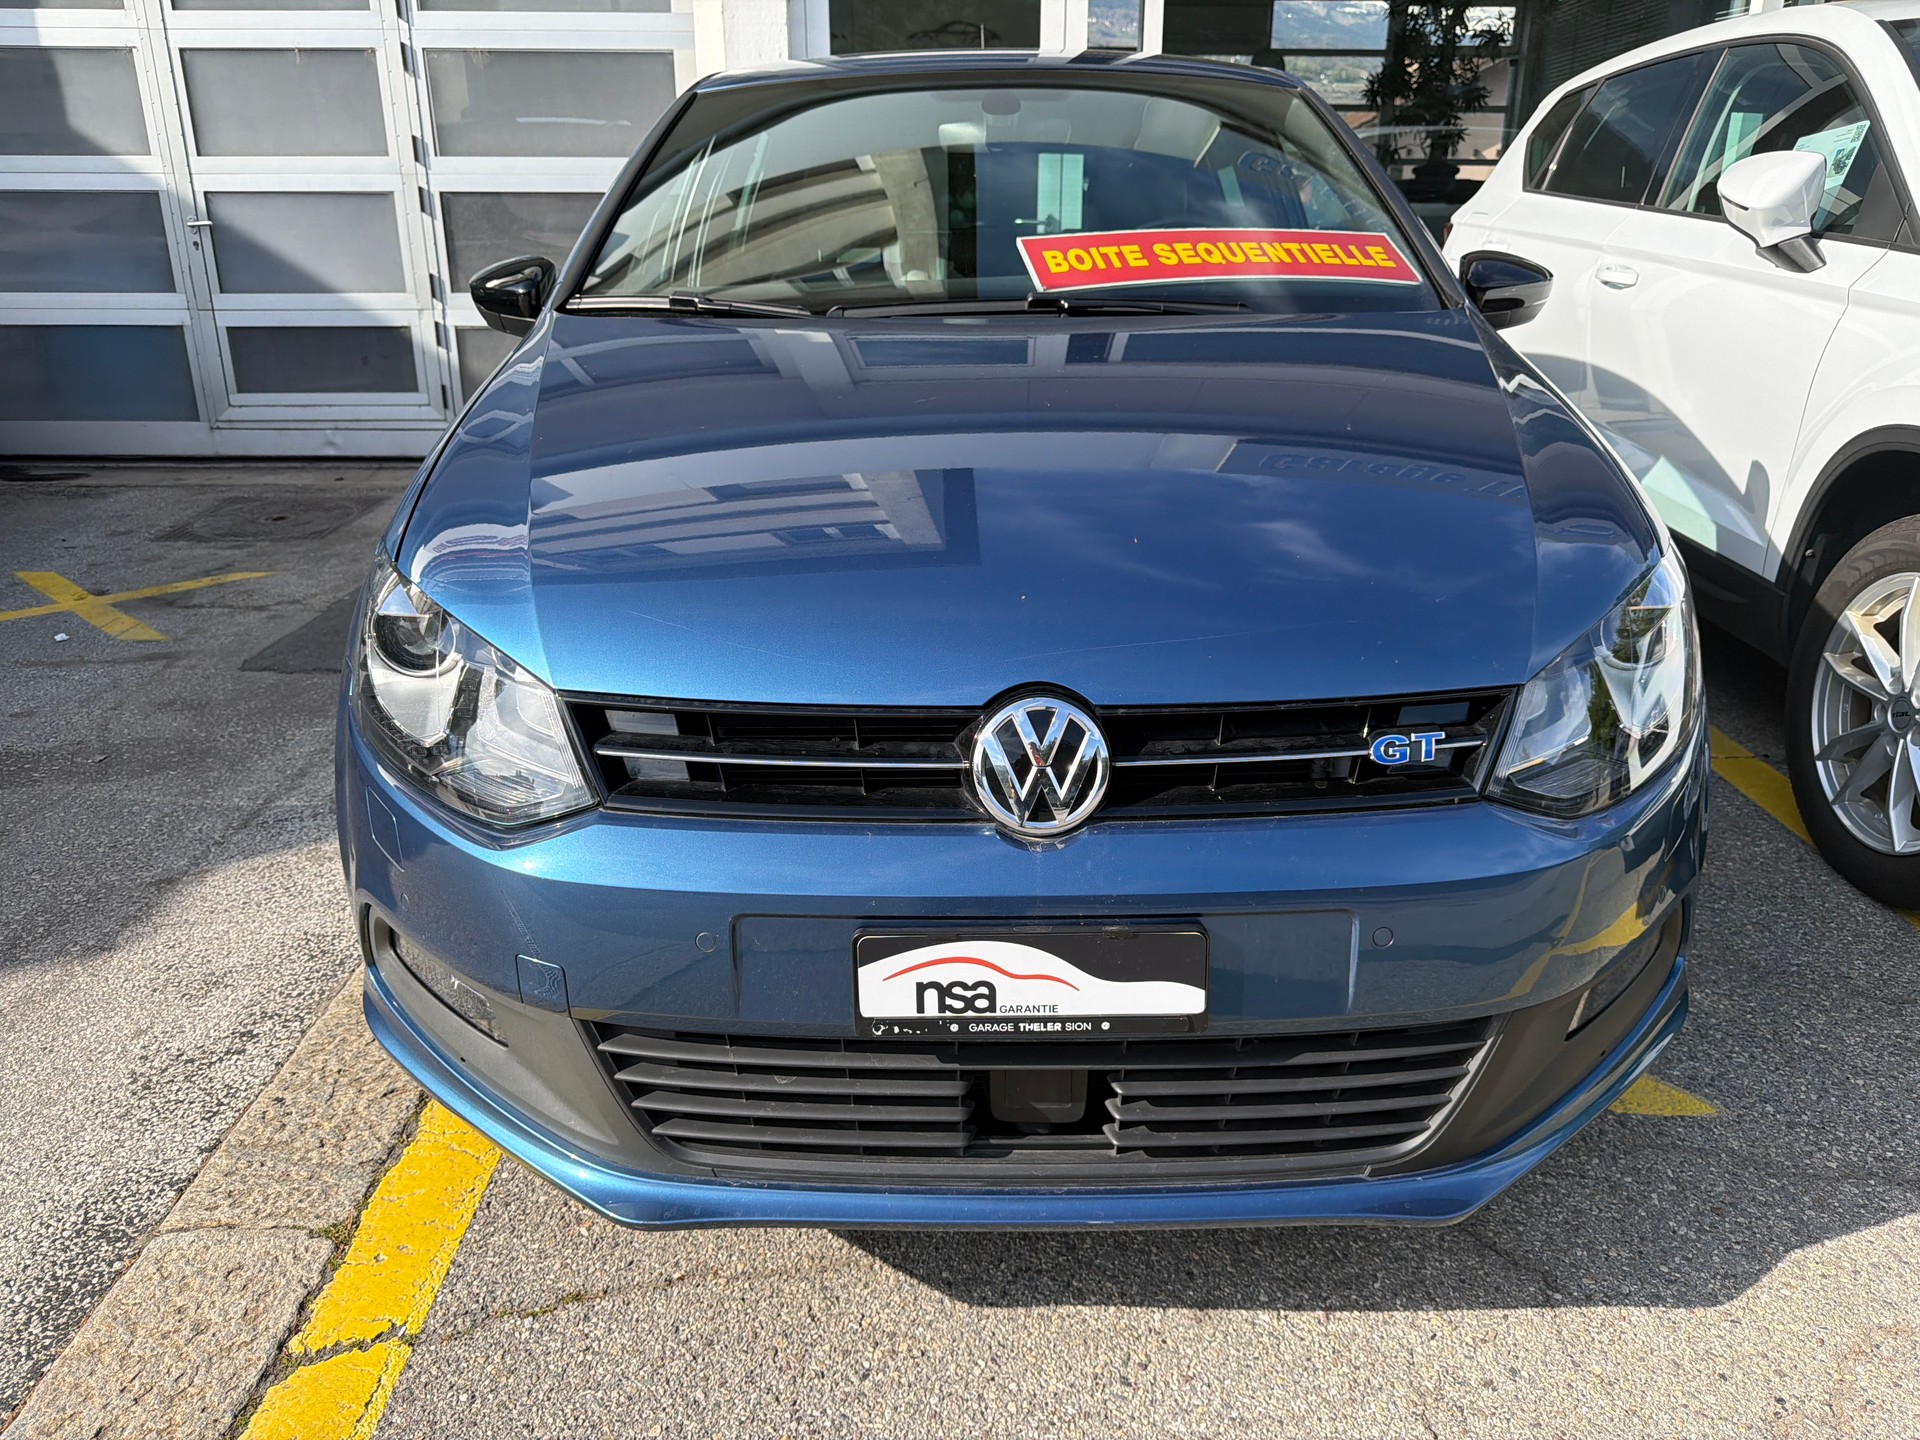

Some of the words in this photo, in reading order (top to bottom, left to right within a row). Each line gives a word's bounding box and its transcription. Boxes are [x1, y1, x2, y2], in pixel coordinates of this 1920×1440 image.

[1042, 244, 1150, 274] BOITE
[1152, 241, 1397, 268] SEQUENTIELLE
[1369, 731, 1446, 765] GT
[915, 980, 997, 1015] nsa
[999, 1004, 1060, 1014] GARANTIE
[968, 1022, 1015, 1033] GARAGE
[1018, 1022, 1062, 1032] THELER
[1065, 1021, 1092, 1032] SION
